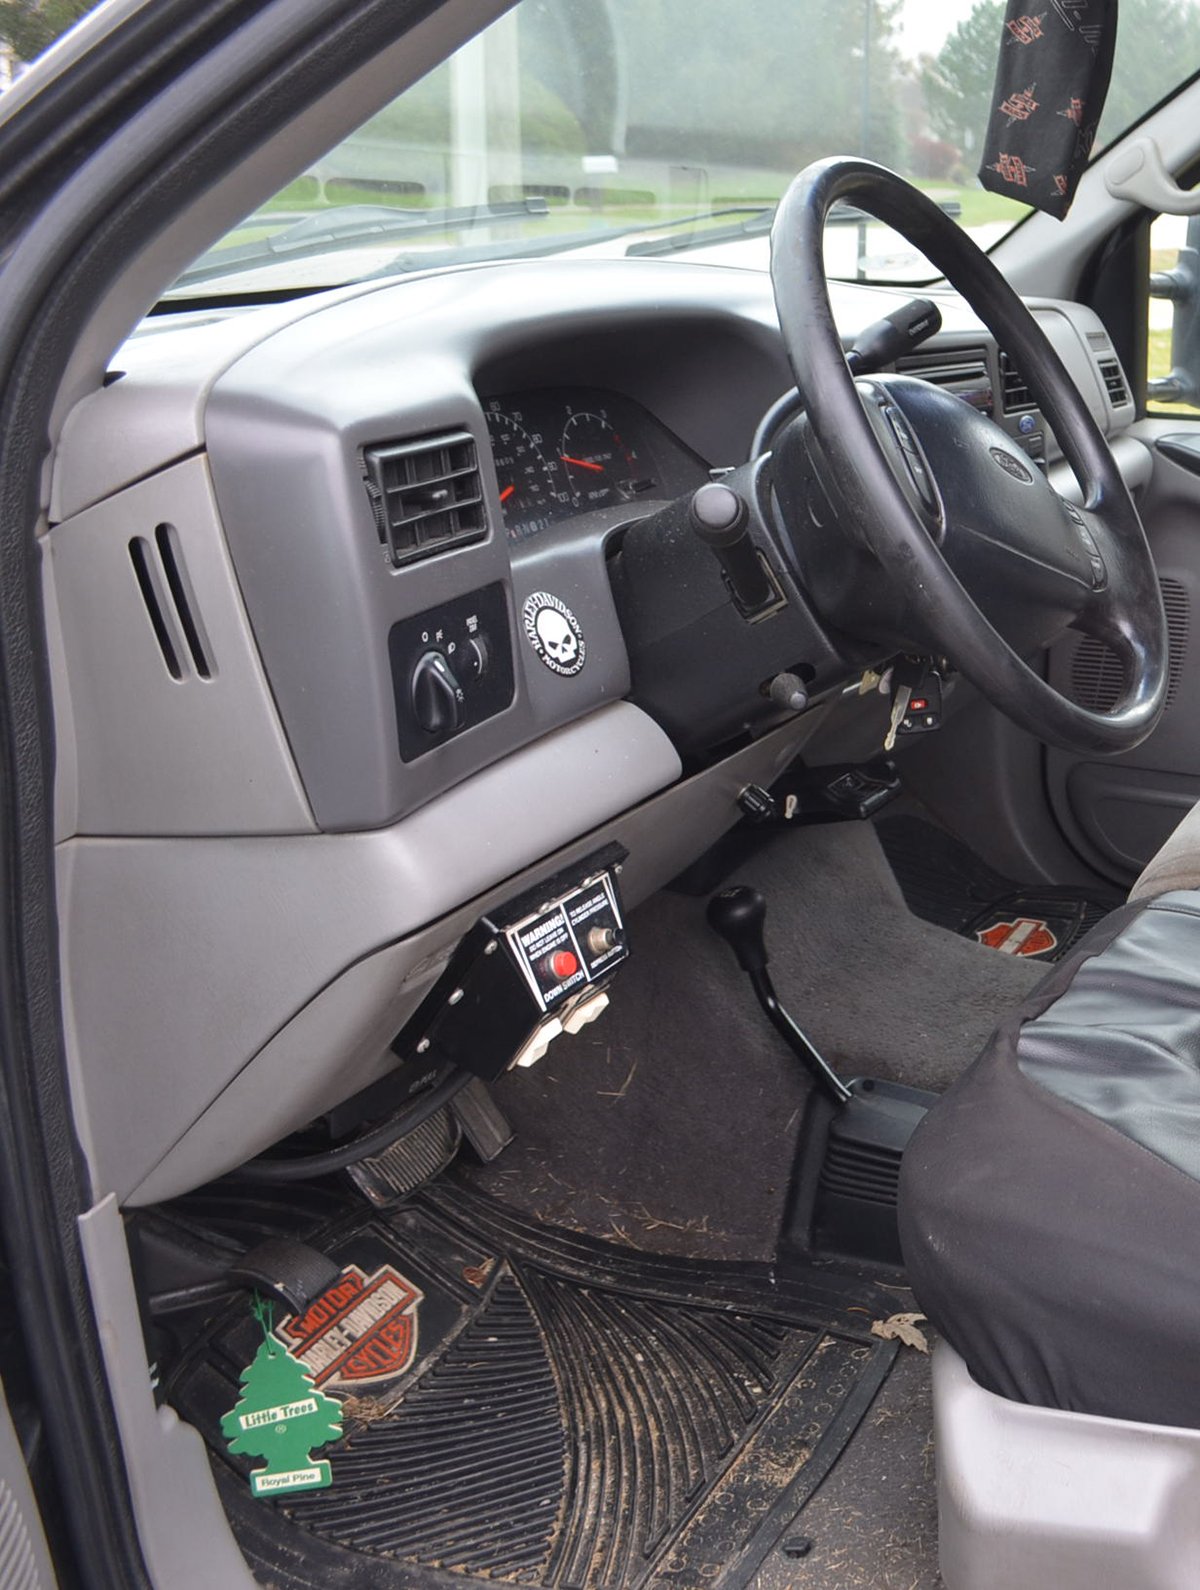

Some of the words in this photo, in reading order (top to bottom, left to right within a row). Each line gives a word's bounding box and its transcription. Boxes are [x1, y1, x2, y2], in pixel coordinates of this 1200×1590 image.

[524, 591, 582, 650] HARLEY-DAVIDSON
[521, 914, 566, 948] WARNING!
[543, 984, 563, 1003] DOWN
[562, 969, 585, 990] SWITCH
[346, 1320, 404, 1370] CYCLES
[245, 1410, 278, 1428] Little
[280, 1403, 314, 1418] Trees
[261, 1475, 290, 1487] Royal
[292, 1473, 316, 1482] Pine
